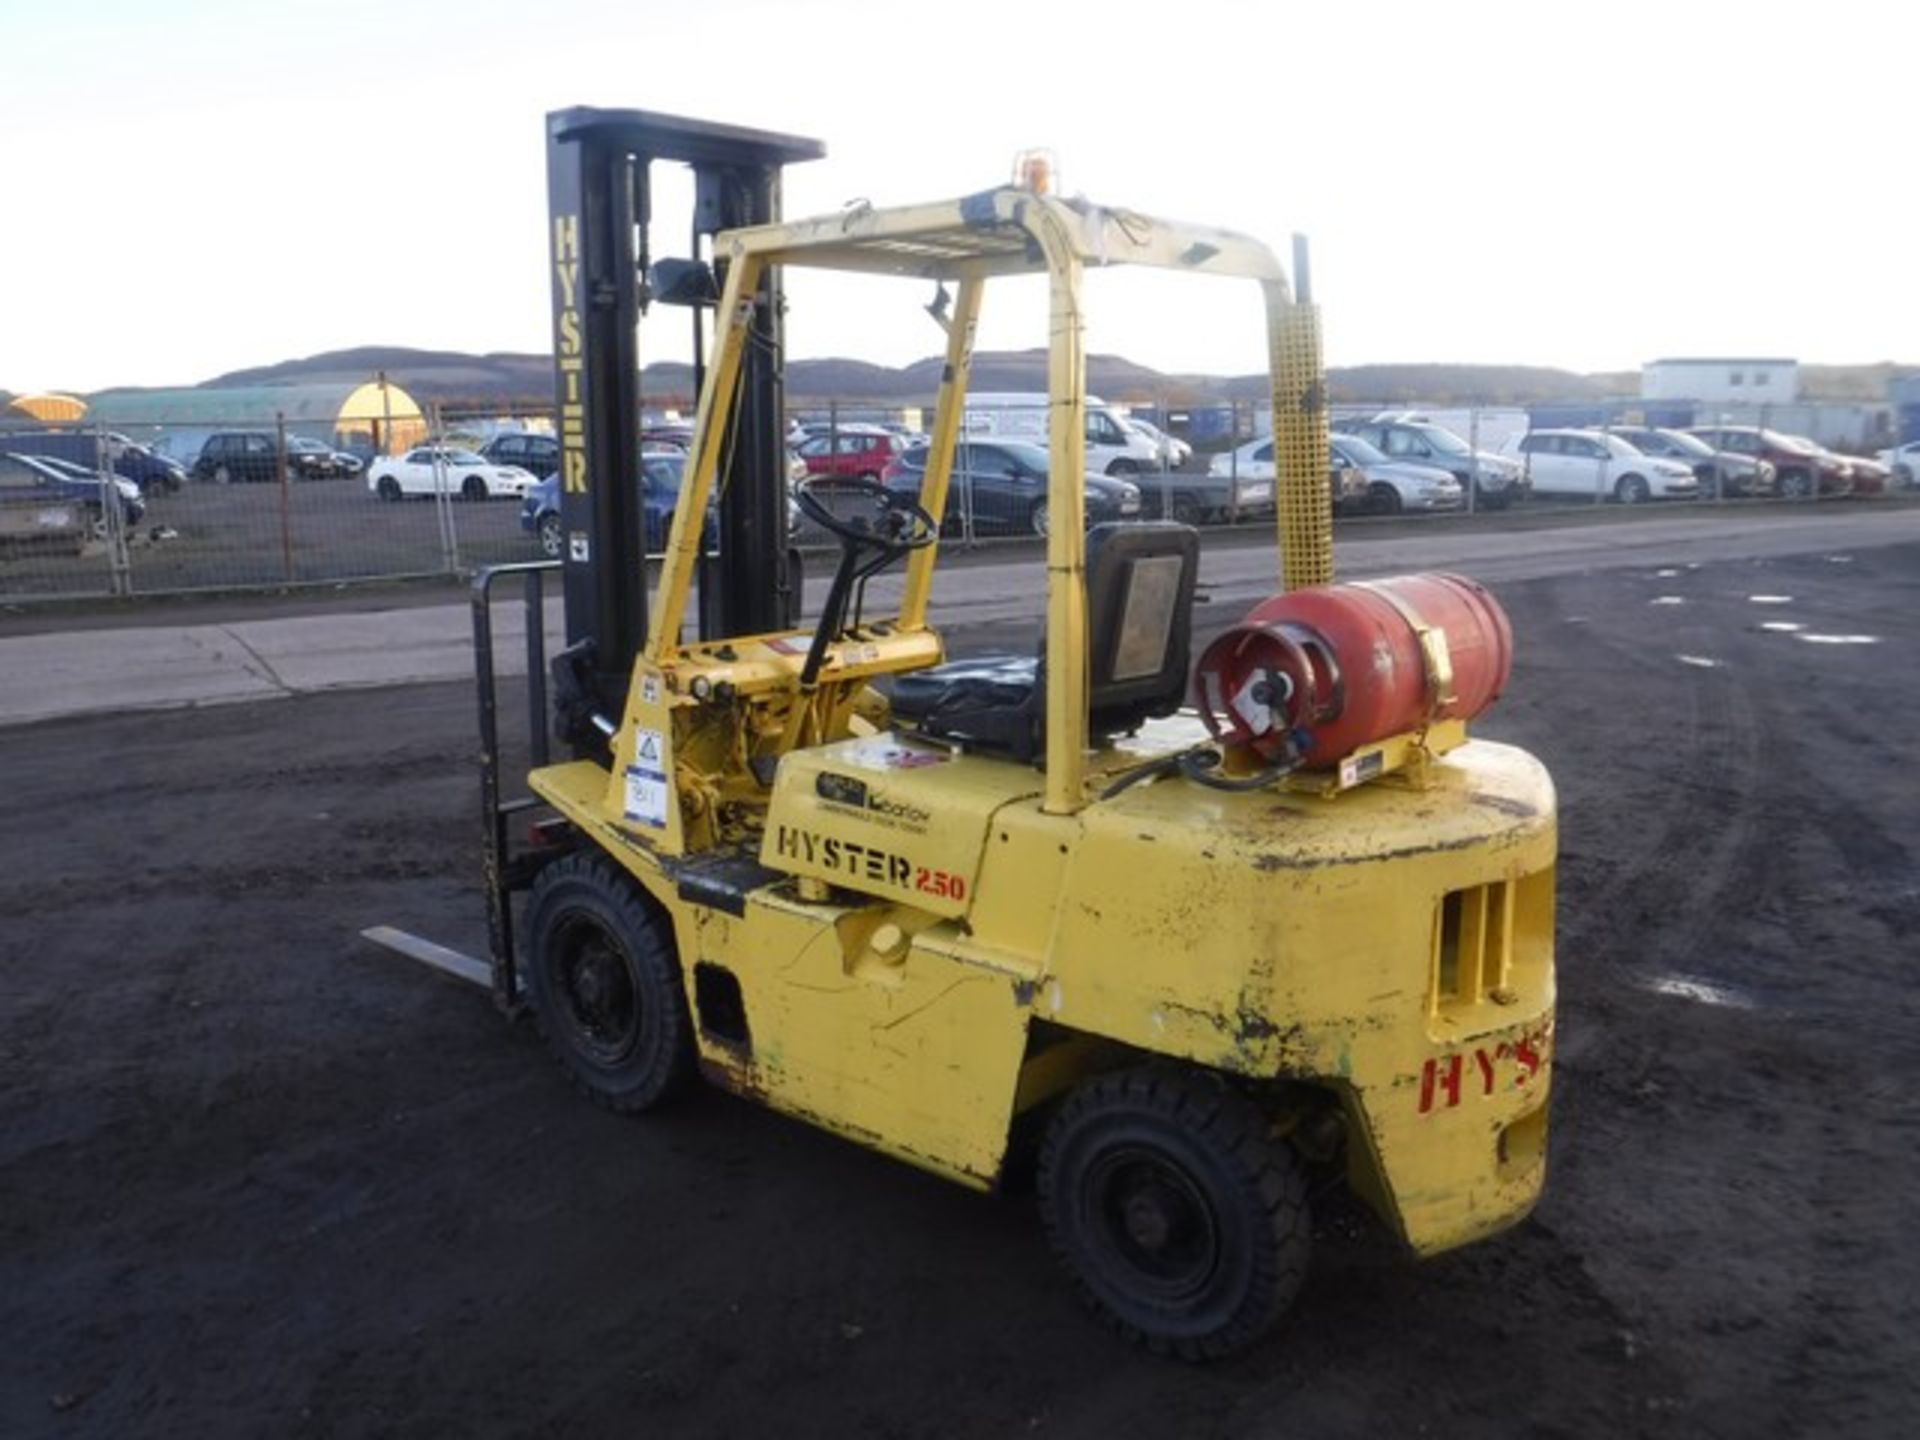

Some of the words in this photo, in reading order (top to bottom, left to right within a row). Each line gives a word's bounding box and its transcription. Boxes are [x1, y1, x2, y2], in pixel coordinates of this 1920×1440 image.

[554, 215, 588, 494] HYSTER
[777, 824, 910, 889] HYSTER
[916, 866, 966, 901] 250
